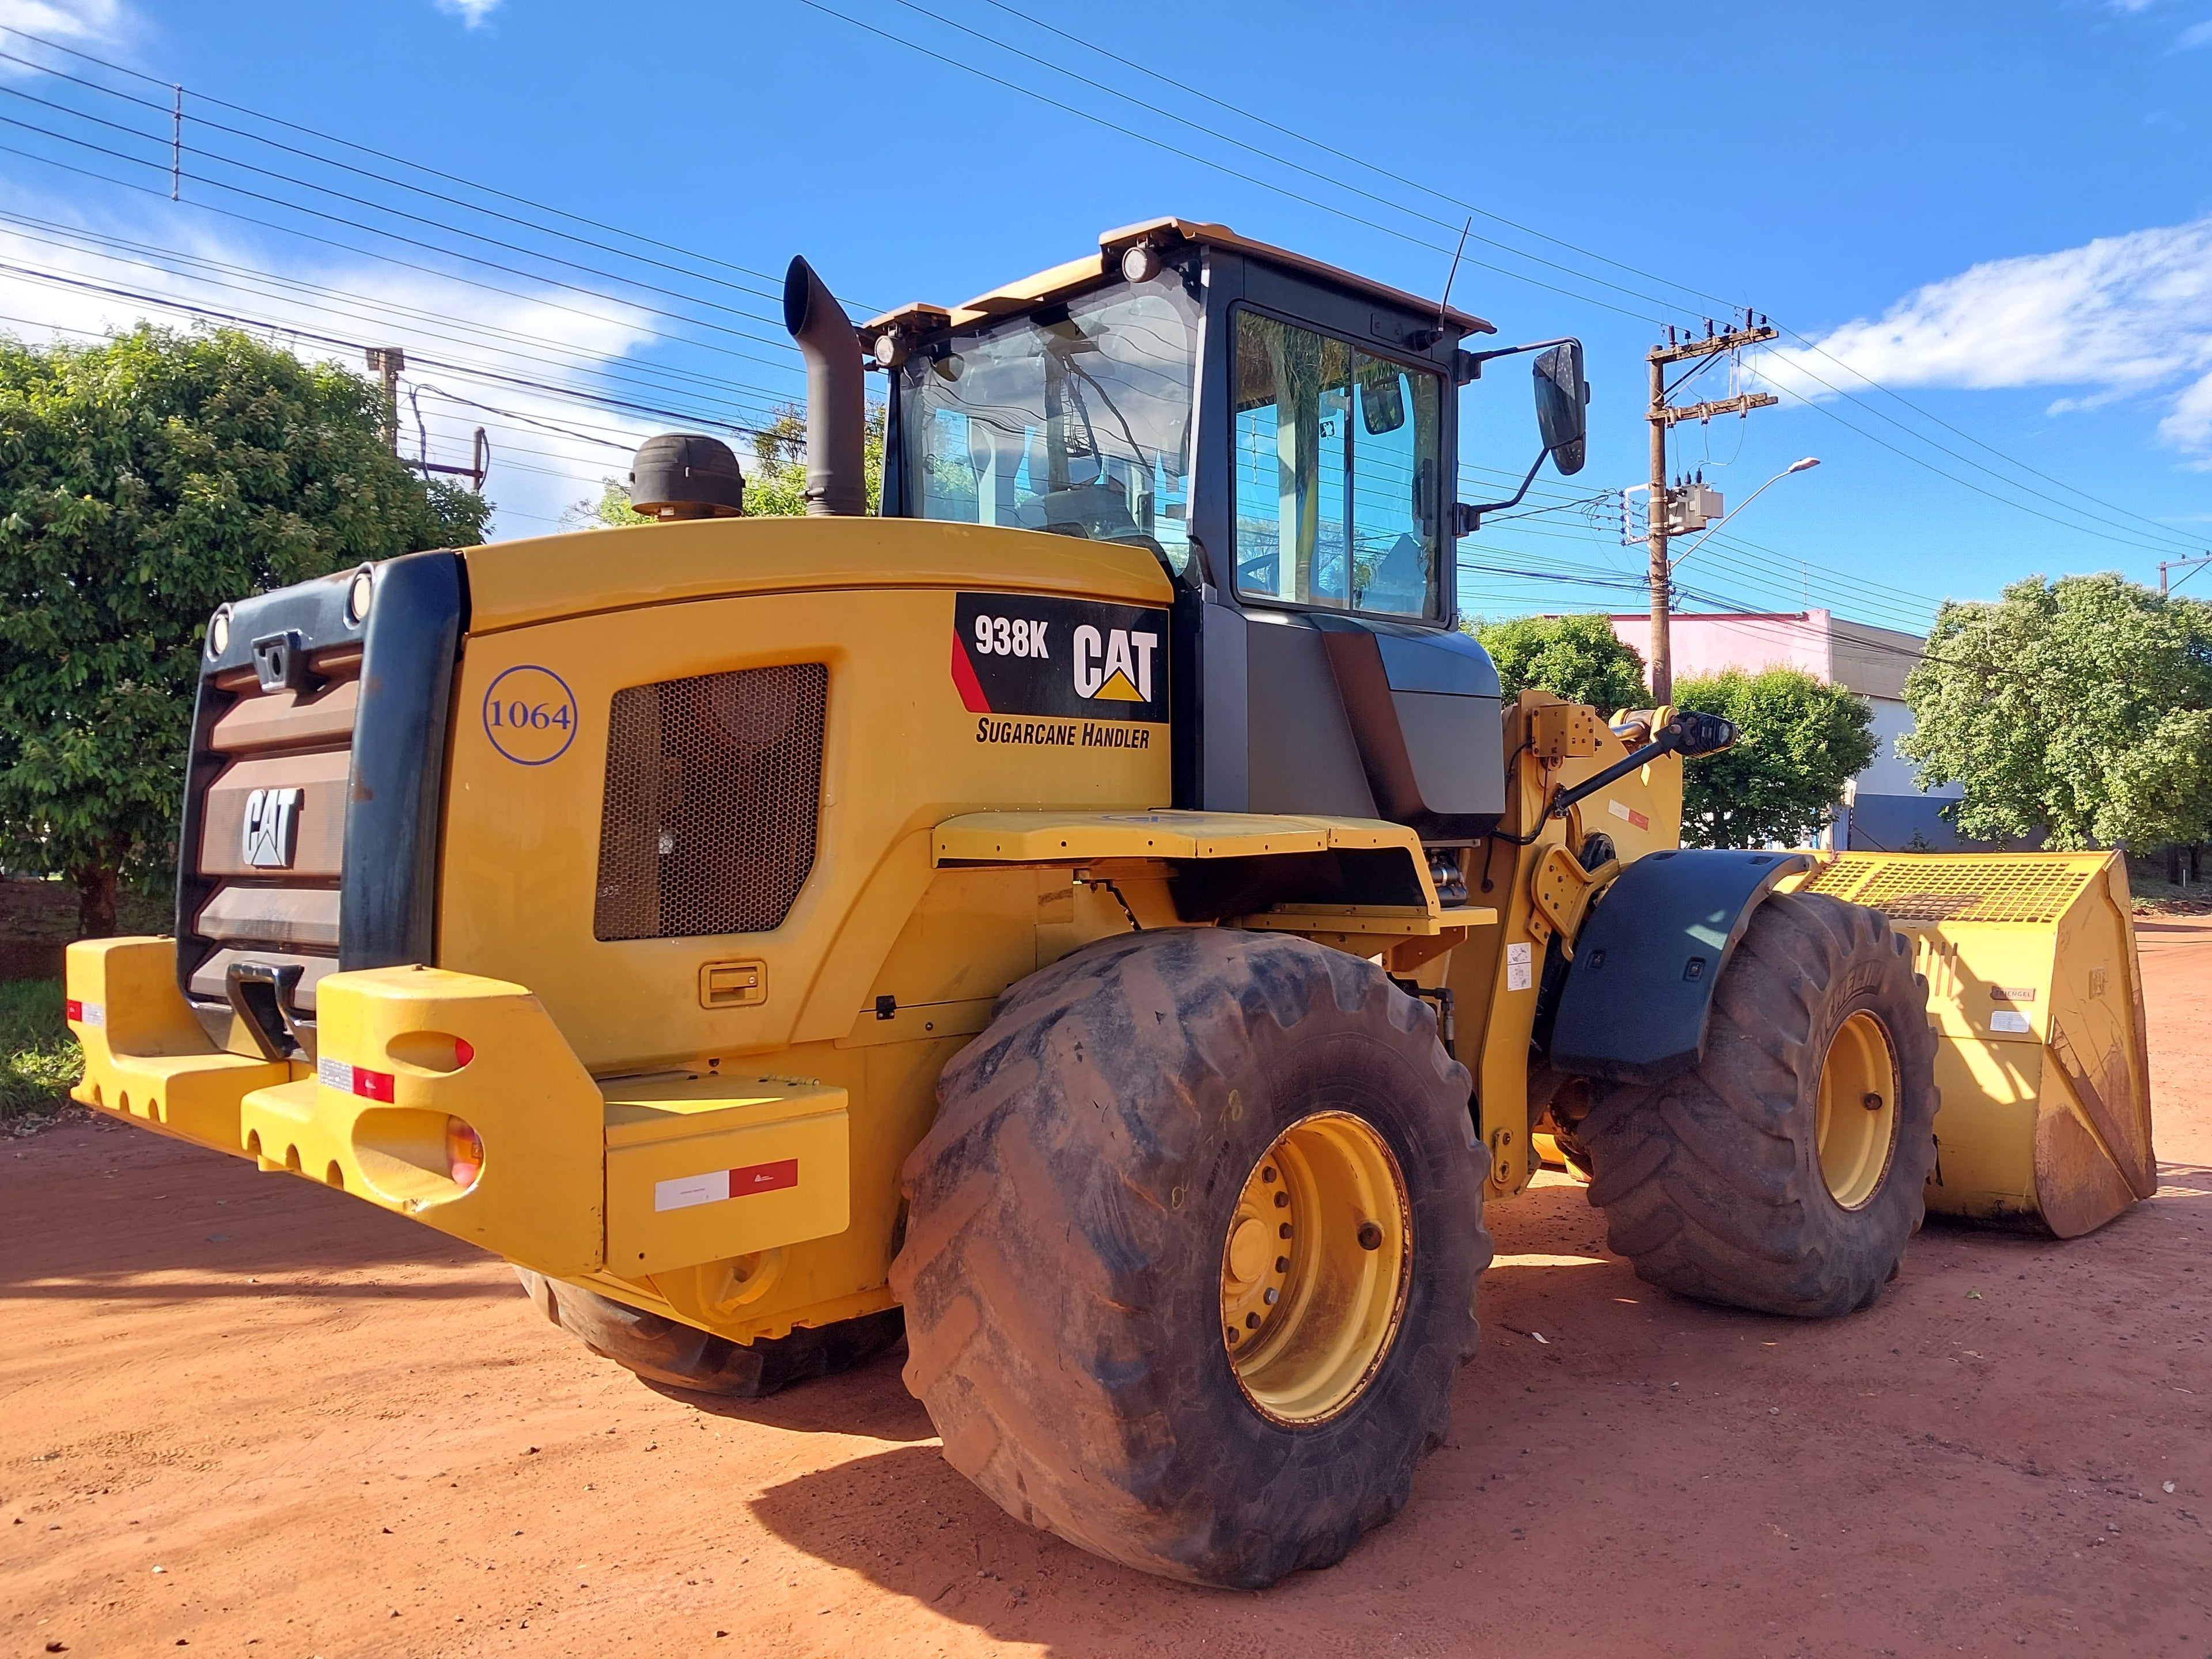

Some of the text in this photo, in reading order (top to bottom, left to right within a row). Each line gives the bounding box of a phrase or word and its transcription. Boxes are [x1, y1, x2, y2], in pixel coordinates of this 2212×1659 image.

[975, 615, 1050, 659] 938K
[1073, 624, 1158, 702] CAT
[489, 699, 571, 730] 1064
[243, 789, 299, 867] CAT
